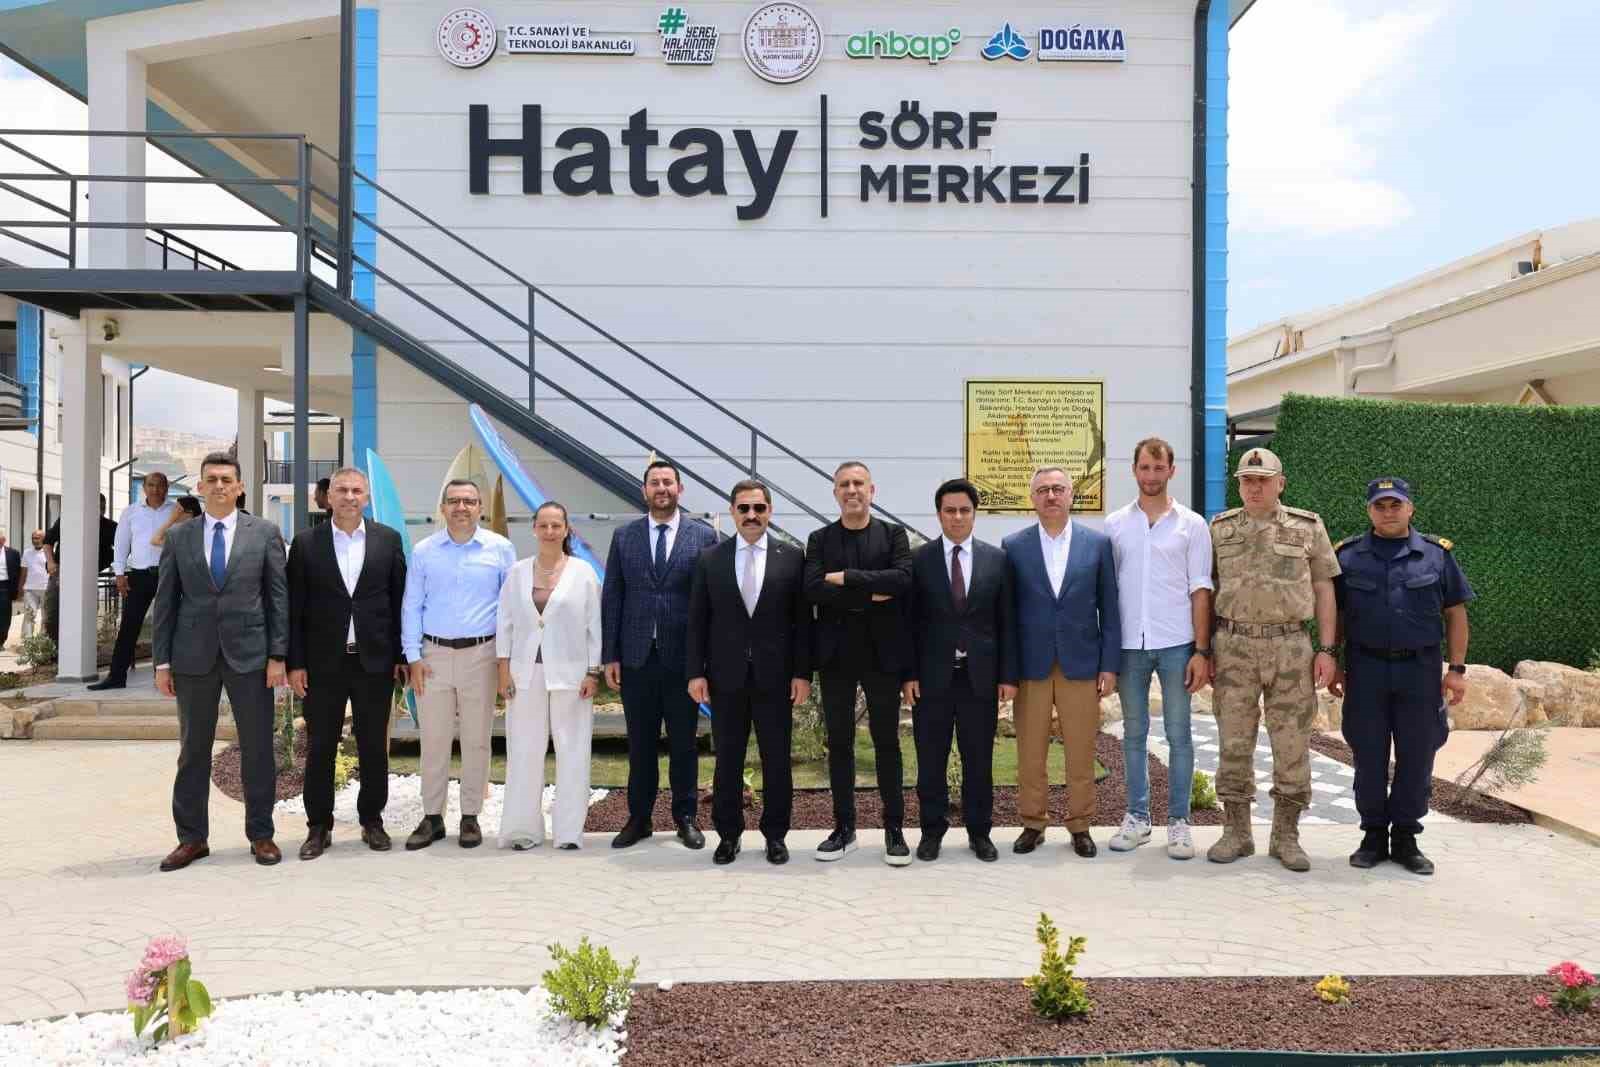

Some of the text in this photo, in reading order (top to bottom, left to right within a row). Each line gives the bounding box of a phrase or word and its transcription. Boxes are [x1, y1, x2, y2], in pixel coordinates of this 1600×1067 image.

[508, 25, 586, 37] T.C. SANAYİ VE
[508, 38, 632, 50] TEKNOLOJİ BAKANLIĞI
[663, 37, 716, 49] KALKINMA
[685, 26, 718, 38] YEREL
[1041, 24, 1125, 50] DOĞAKA
[847, 31, 953, 61] ahbap
[859, 100, 998, 150] SÖRF
[468, 103, 799, 221] Hatay
[860, 152, 1090, 205] MERKEZİ
